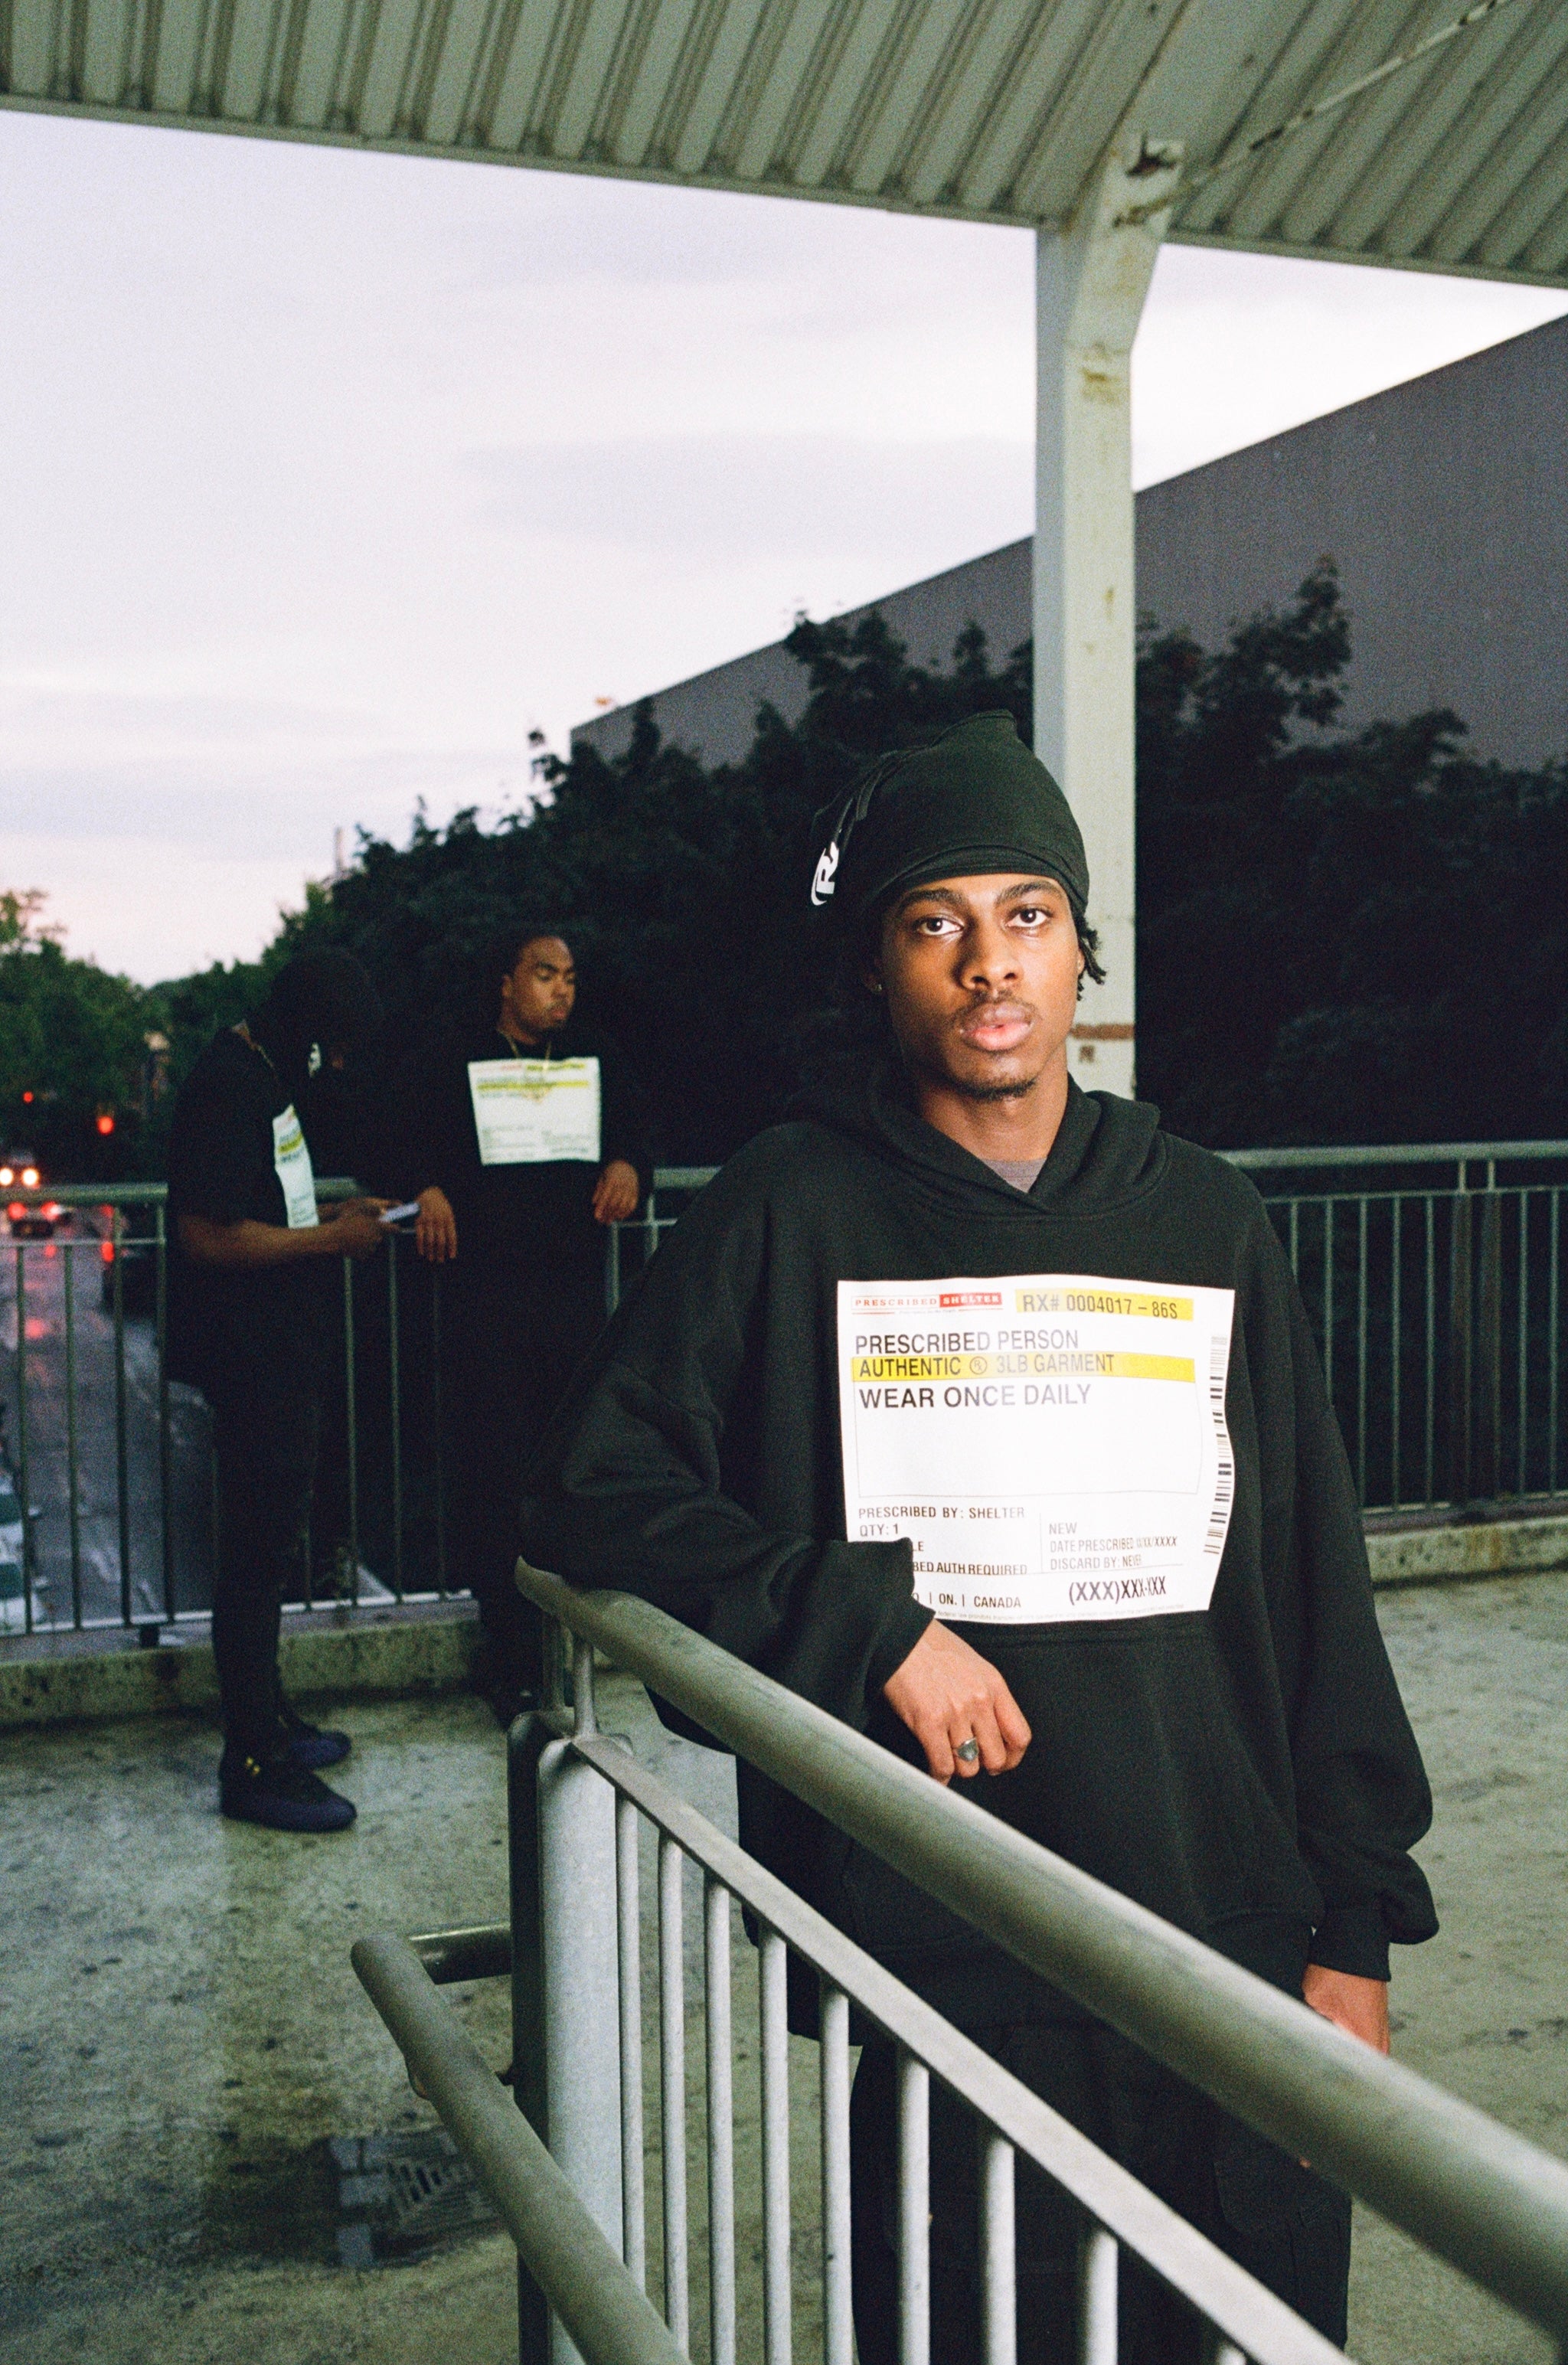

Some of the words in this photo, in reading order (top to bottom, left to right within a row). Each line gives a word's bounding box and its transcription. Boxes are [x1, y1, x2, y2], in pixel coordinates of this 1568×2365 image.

[854, 1298, 937, 1308] PRESCRIBED
[942, 1295, 1000, 1305] SHELTER
[1022, 1294, 1060, 1312] RX#
[1067, 1295, 1132, 1315] 0004017
[1152, 1301, 1178, 1320] 86S
[855, 1331, 991, 1354] PRESCRIBED
[998, 1330, 1080, 1351] PERSON
[859, 1357, 962, 1378] AUTHENTIC
[996, 1354, 1028, 1374] 3LB
[1034, 1353, 1115, 1373] GARMENT
[859, 1387, 935, 1409] WEAR
[943, 1385, 1016, 1407] ONCE
[1024, 1383, 1093, 1405] DAILY
[858, 1506, 936, 1519] PRESCRIBED
[969, 1507, 1025, 1519] SHELTER
[860, 1524, 890, 1537] QTY:
[893, 1523, 899, 1534] 1
[1049, 1521, 1078, 1535] NEW
[1050, 1540, 1076, 1553] DATE
[1078, 1537, 1134, 1552] PRESCRIBED
[936, 1562, 966, 1574] AUTH
[968, 1563, 1028, 1576] REQUIRED
[1050, 1557, 1100, 1571] DISCARD
[938, 1592, 958, 1606] ON.
[973, 1596, 1022, 1609] CANADA
